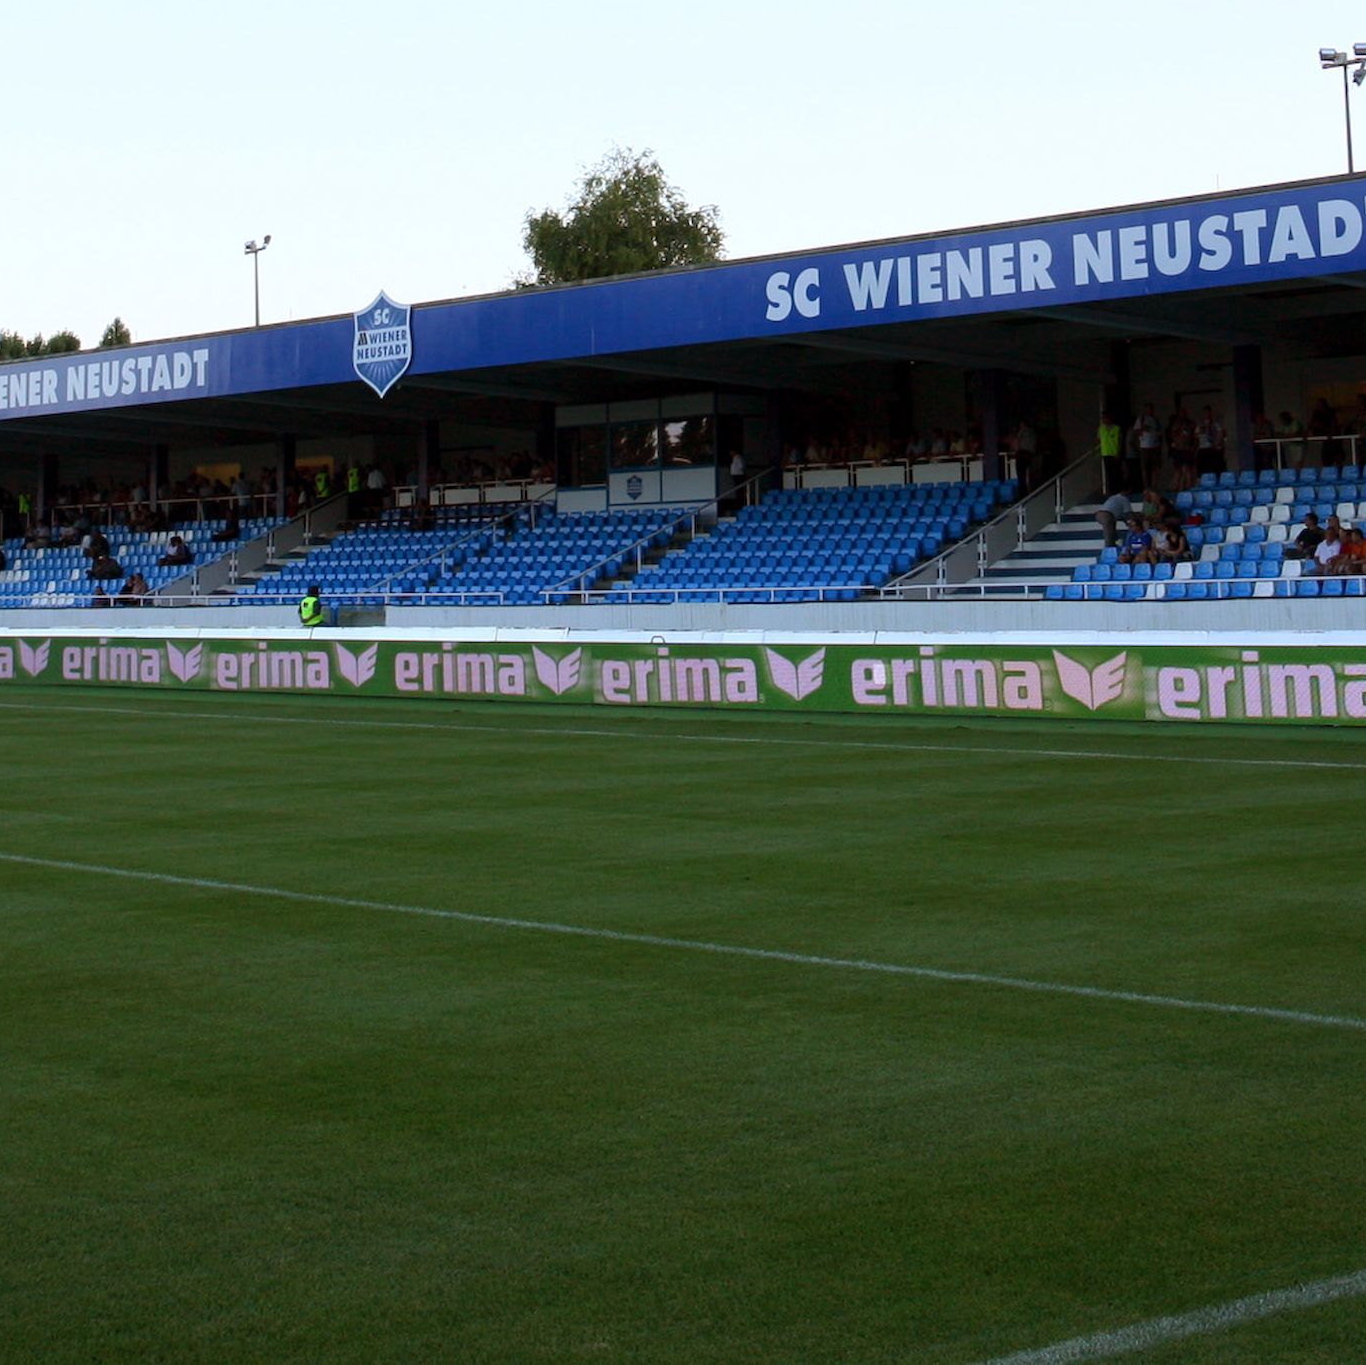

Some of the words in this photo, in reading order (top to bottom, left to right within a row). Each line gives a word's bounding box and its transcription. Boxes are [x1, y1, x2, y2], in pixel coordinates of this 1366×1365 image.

[765, 268, 820, 322] SC
[843, 239, 1056, 312] WIENER
[369, 330, 407, 344] WIENER
[374, 308, 390, 325] SC
[66, 348, 209, 402] NEUSTADT
[357, 344, 407, 360] NEUSTADT
[62, 639, 161, 683] erima
[216, 642, 330, 689] erima
[394, 643, 526, 696] erima
[600, 647, 758, 703] erima
[850, 646, 1044, 710] erima
